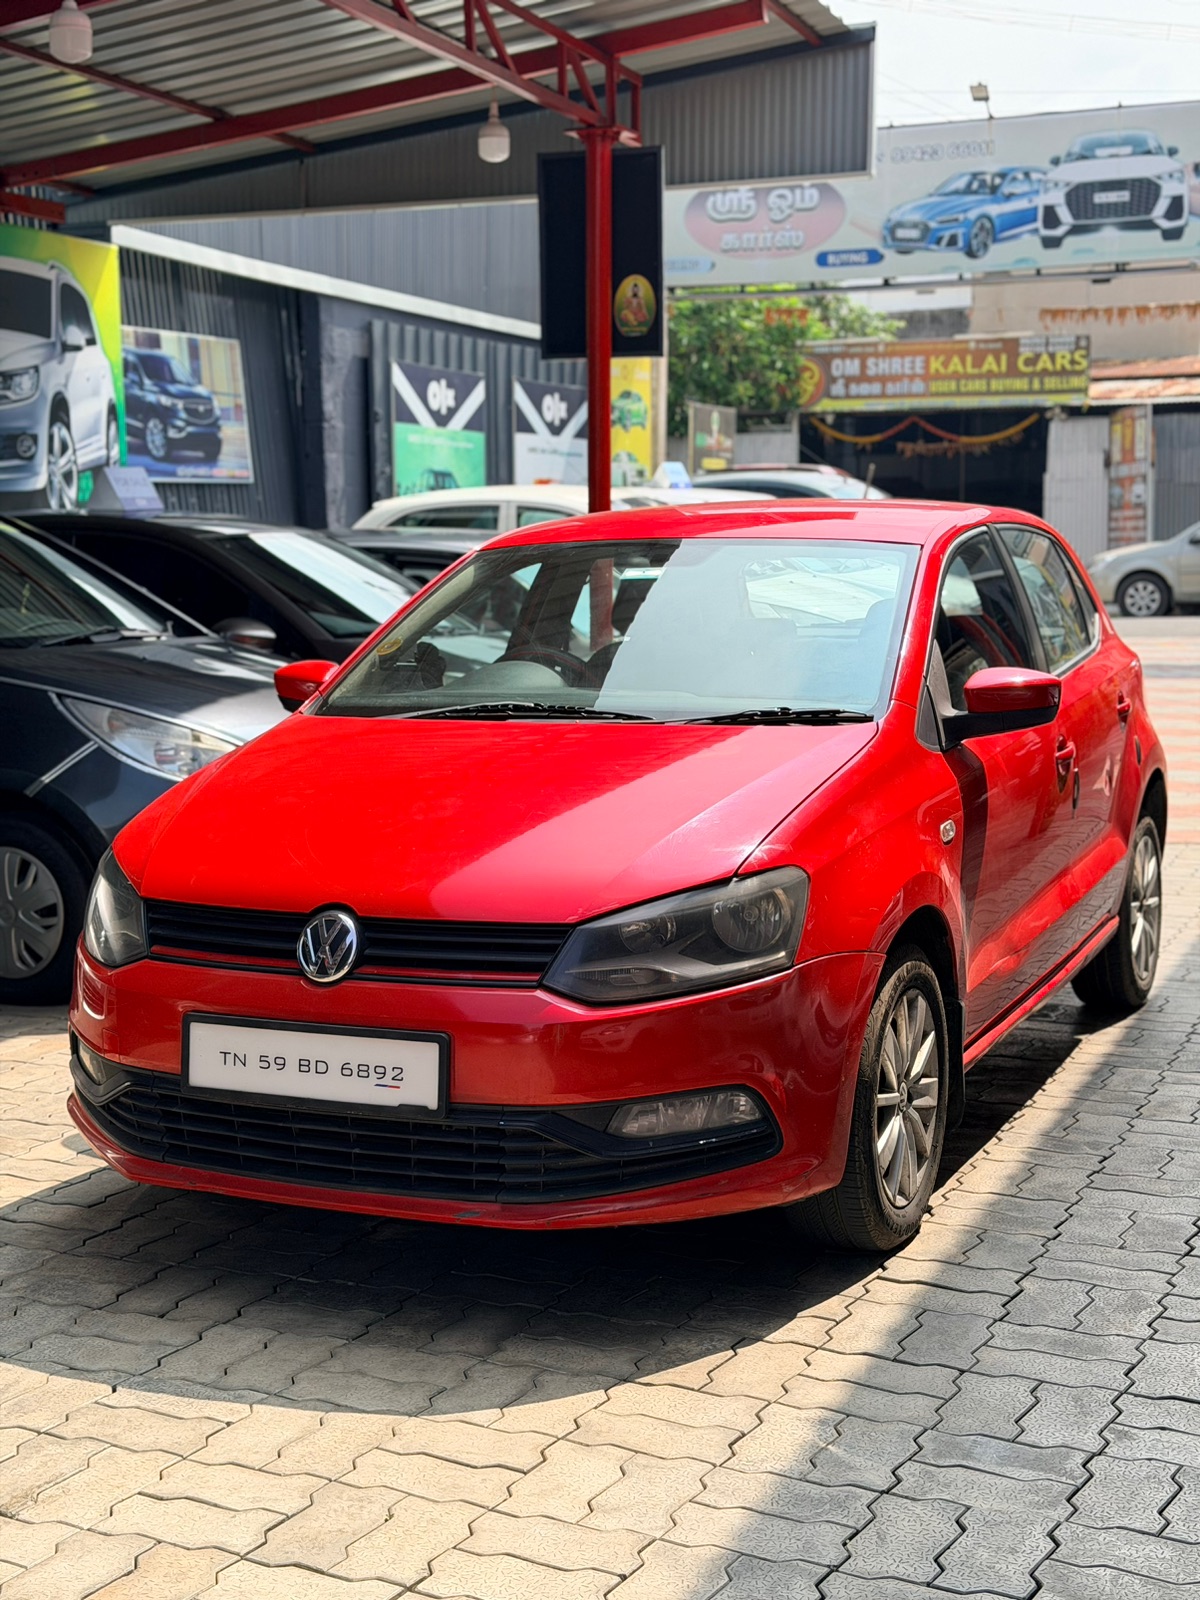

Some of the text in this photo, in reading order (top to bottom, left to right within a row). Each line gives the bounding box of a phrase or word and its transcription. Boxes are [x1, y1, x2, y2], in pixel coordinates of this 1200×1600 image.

[830, 350, 1089, 377] OM SHREE KALAI CARS
[959, 377, 987, 393] CARS
[989, 376, 1029, 392] BUYING
[219, 1051, 404, 1082] TN 59 BD 6892
